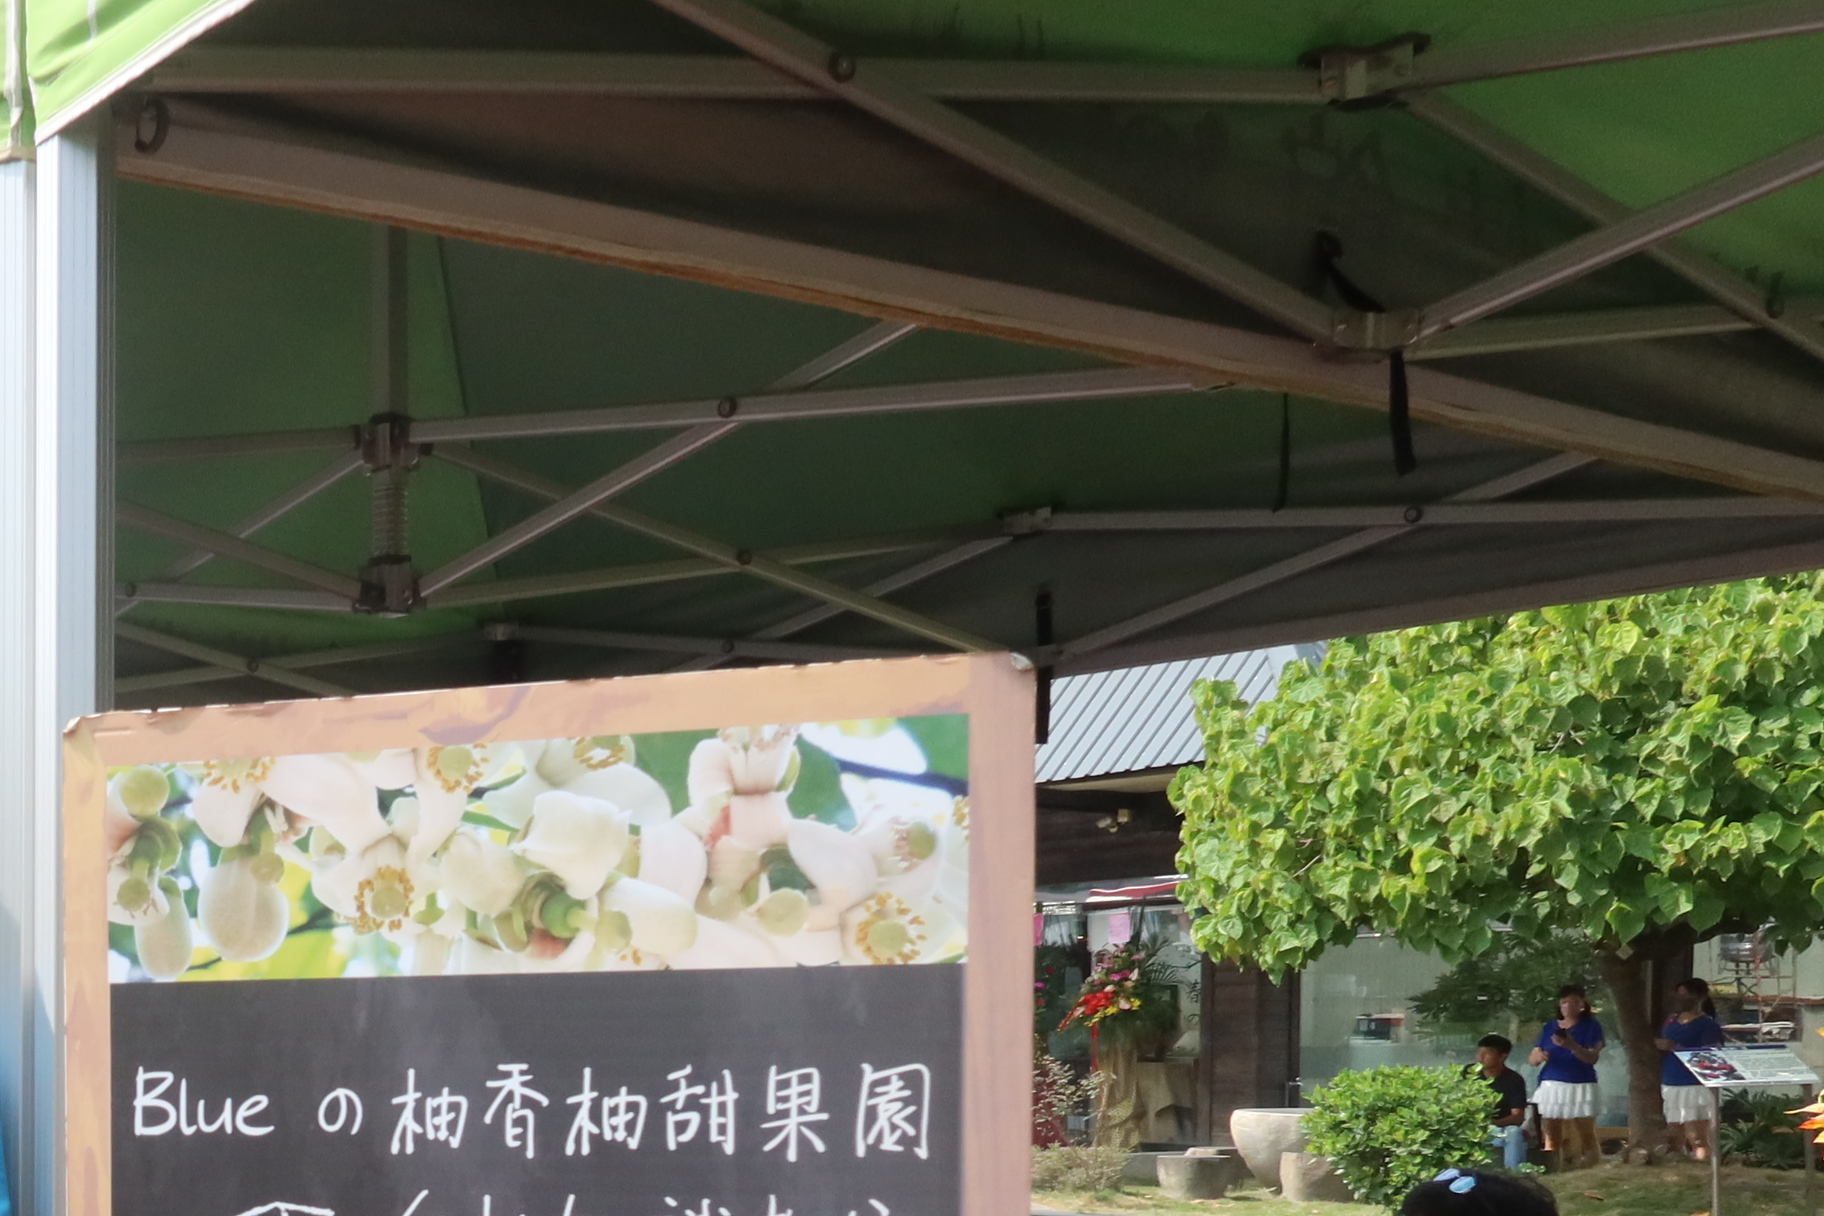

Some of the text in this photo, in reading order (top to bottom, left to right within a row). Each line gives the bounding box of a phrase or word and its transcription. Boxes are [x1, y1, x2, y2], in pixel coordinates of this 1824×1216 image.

[133, 1062, 931, 1162] Blue の 柚香柚甜果園
